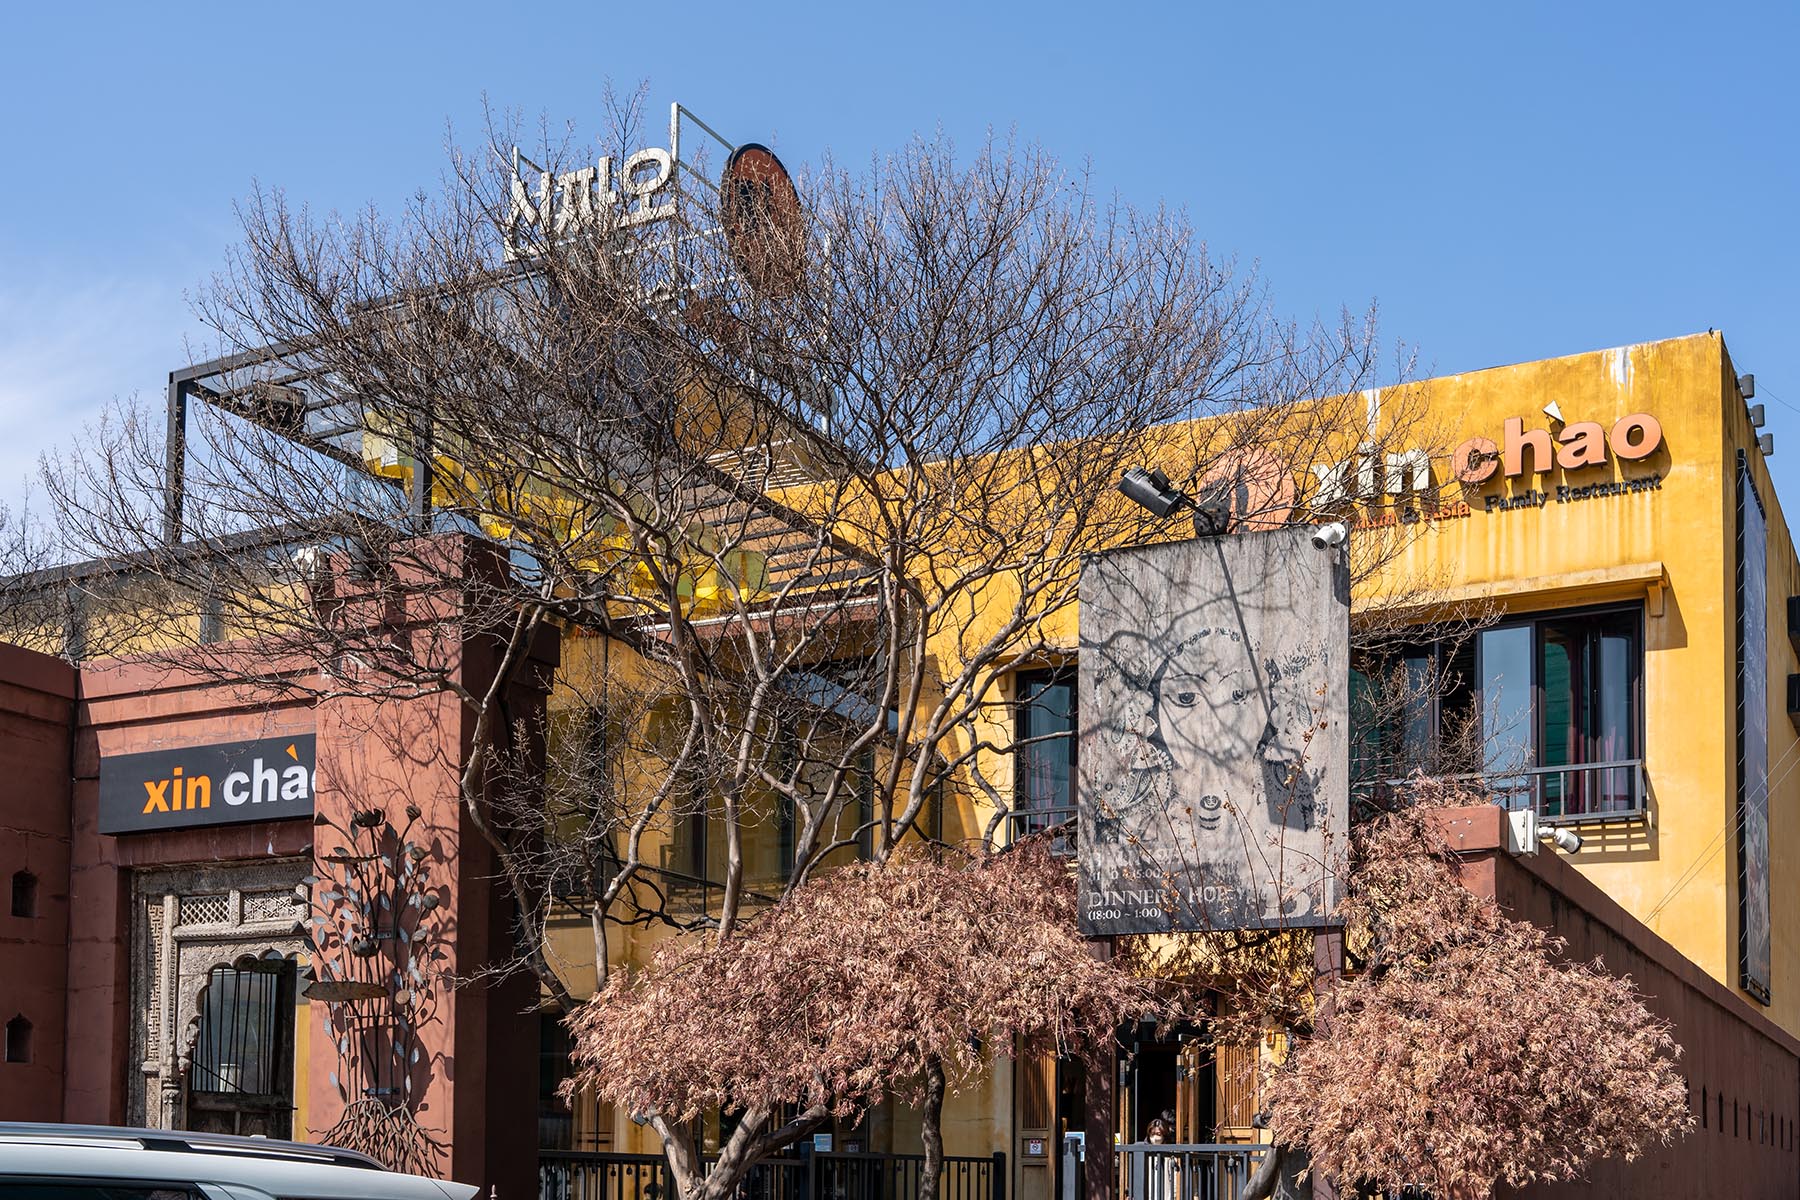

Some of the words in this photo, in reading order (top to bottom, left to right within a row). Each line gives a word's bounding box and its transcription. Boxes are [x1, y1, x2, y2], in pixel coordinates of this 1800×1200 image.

[1310, 439, 1430, 507] xin
[1485, 489, 1549, 514] Family
[1555, 473, 1663, 505] Restaurant
[142, 766, 212, 814] xin
[222, 743, 316, 806] chà
[1088, 888, 1170, 908] DINNER
[1088, 909, 1121, 921] (18:00
